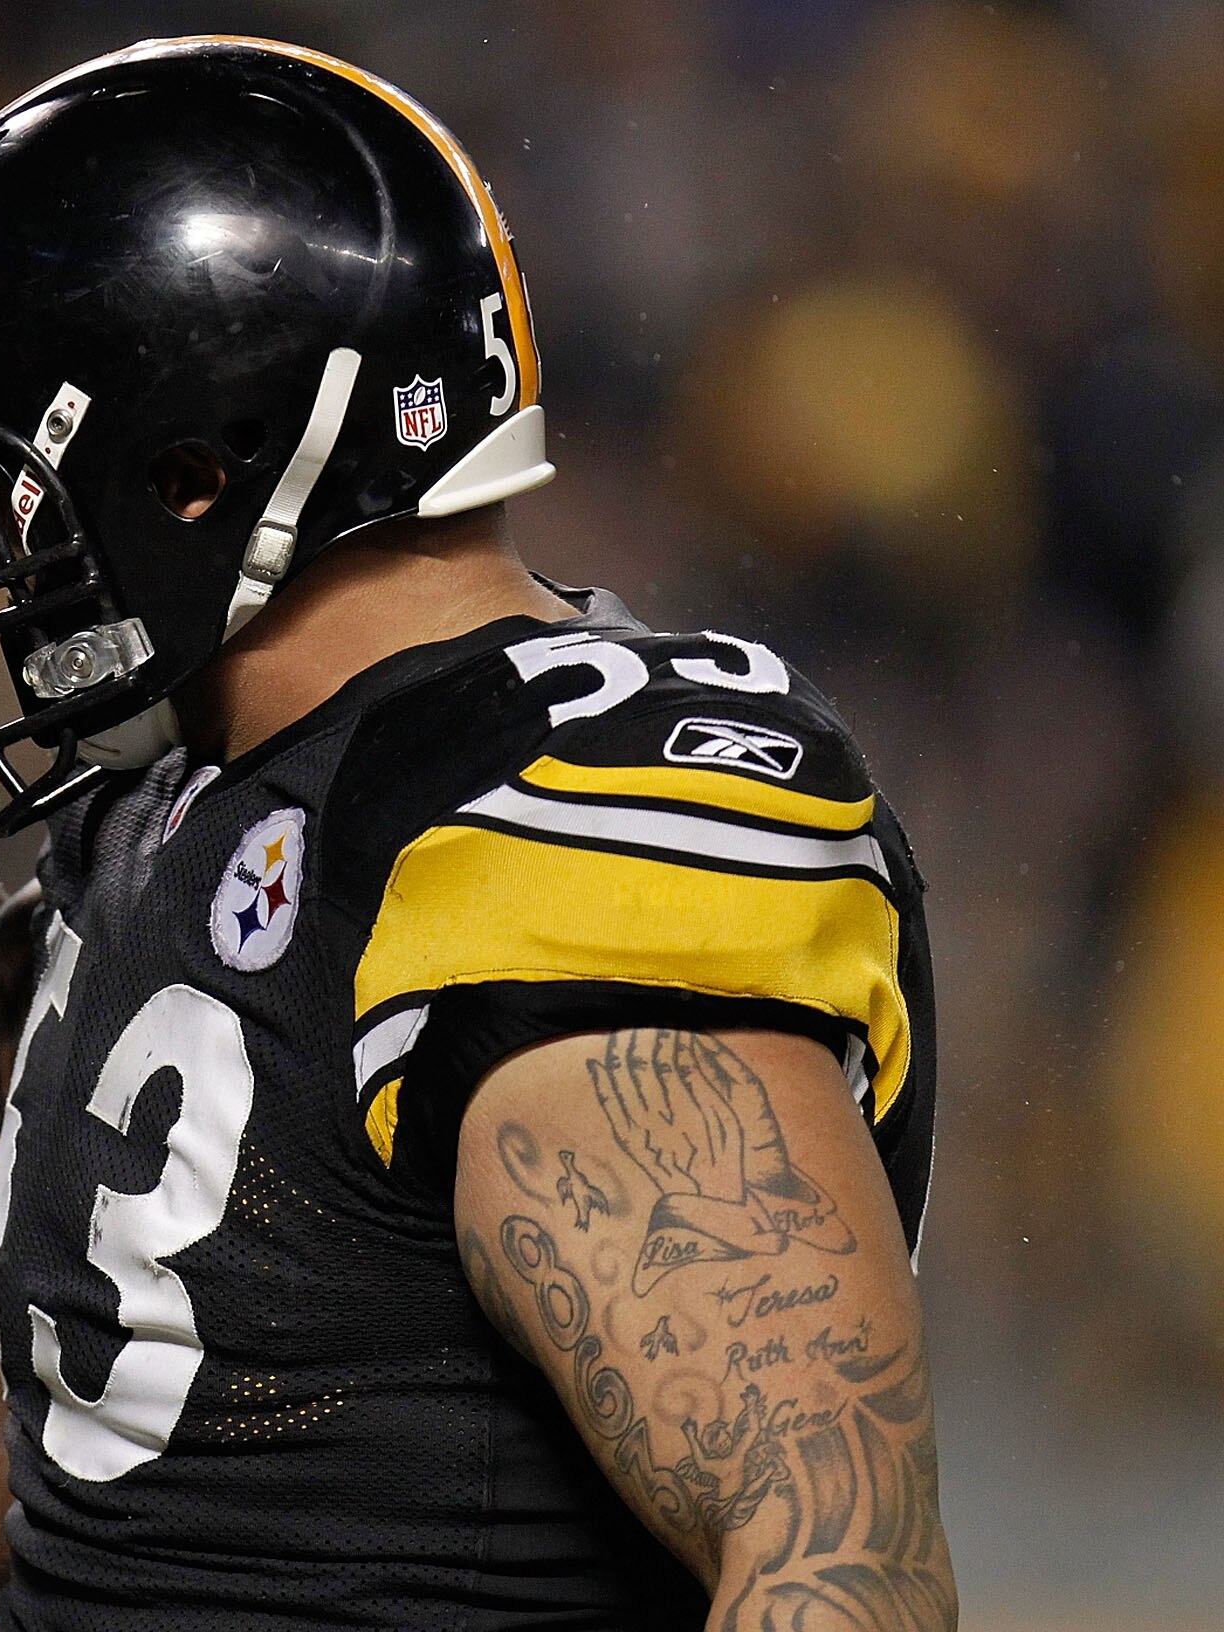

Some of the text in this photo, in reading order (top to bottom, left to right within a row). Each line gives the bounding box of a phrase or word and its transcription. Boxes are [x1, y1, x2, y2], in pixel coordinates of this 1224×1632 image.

[479, 291, 517, 417] 5
[403, 406, 443, 439] NFL
[233, 860, 262, 891] Steelers
[643, 1236, 699, 1270] Lisa
[724, 1273, 839, 1328] Teresa
